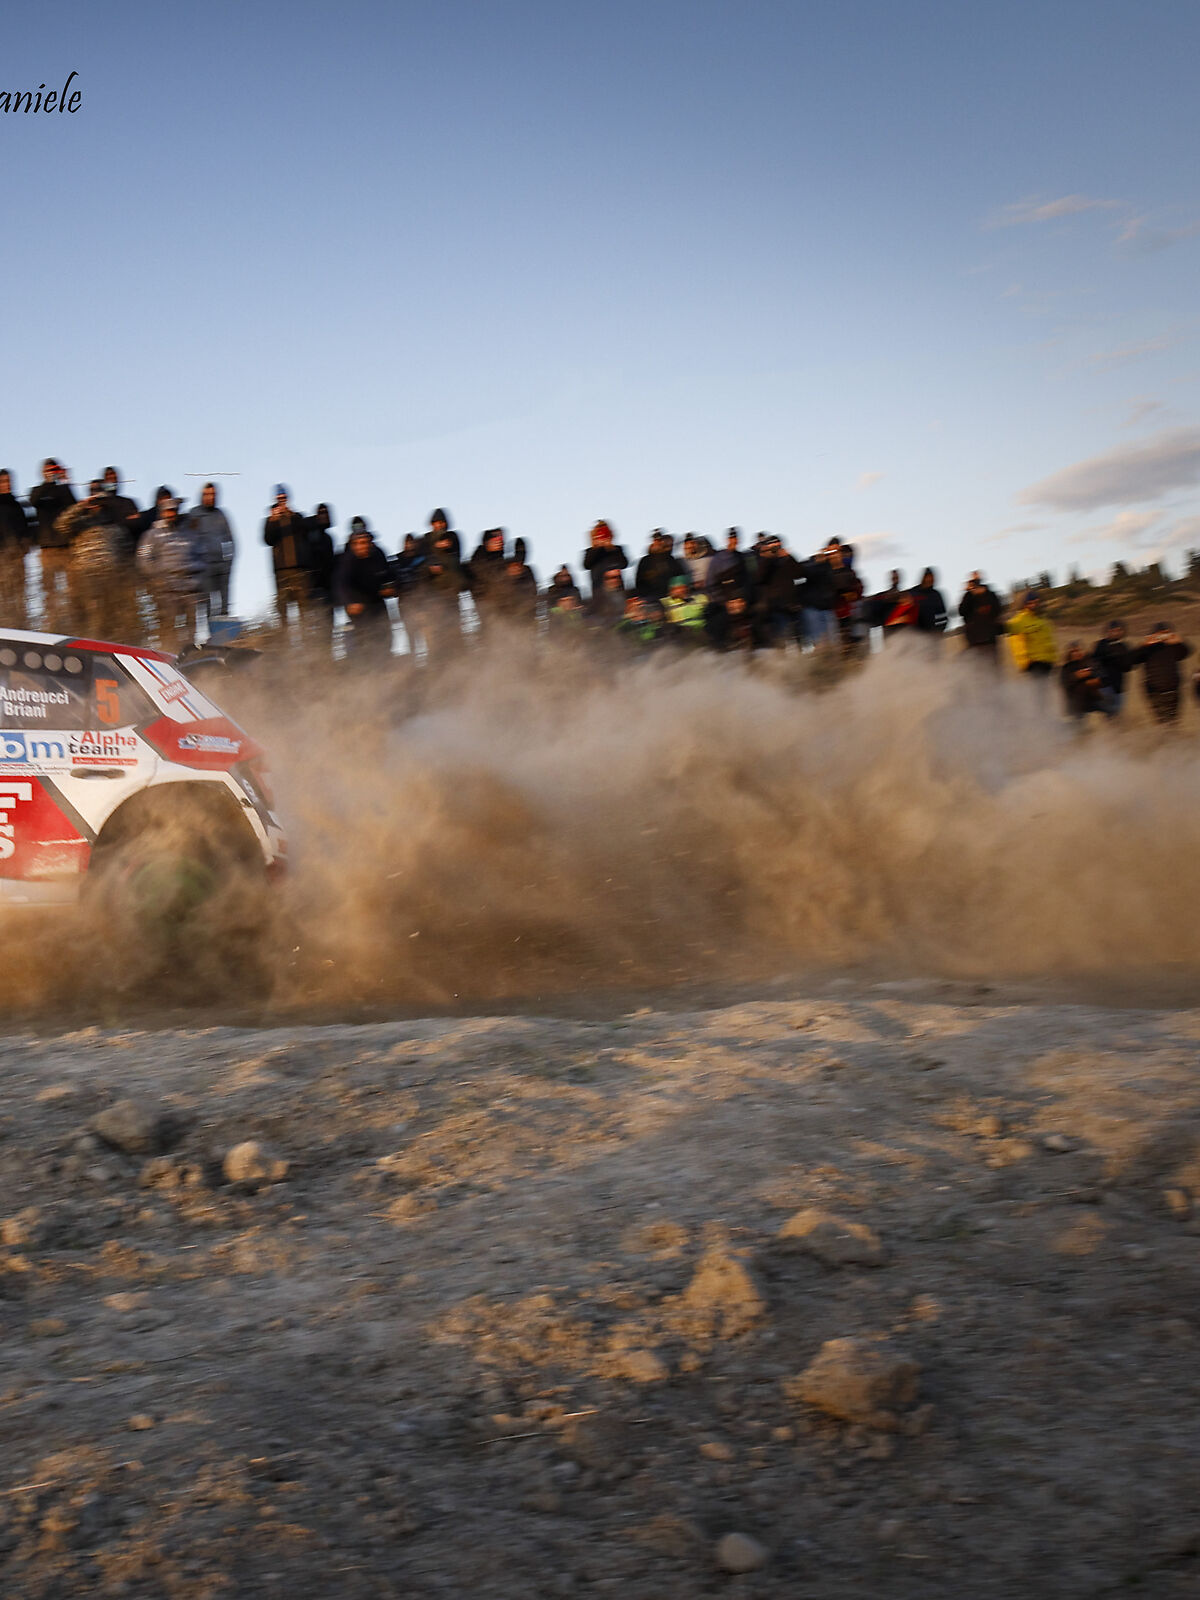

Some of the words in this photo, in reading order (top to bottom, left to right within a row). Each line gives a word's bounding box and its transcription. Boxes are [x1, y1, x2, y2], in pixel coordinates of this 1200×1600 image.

[95, 678, 121, 724] 5
[3, 702, 47, 719] Briani
[69, 741, 120, 756] team
[81, 731, 137, 749] Alpha
